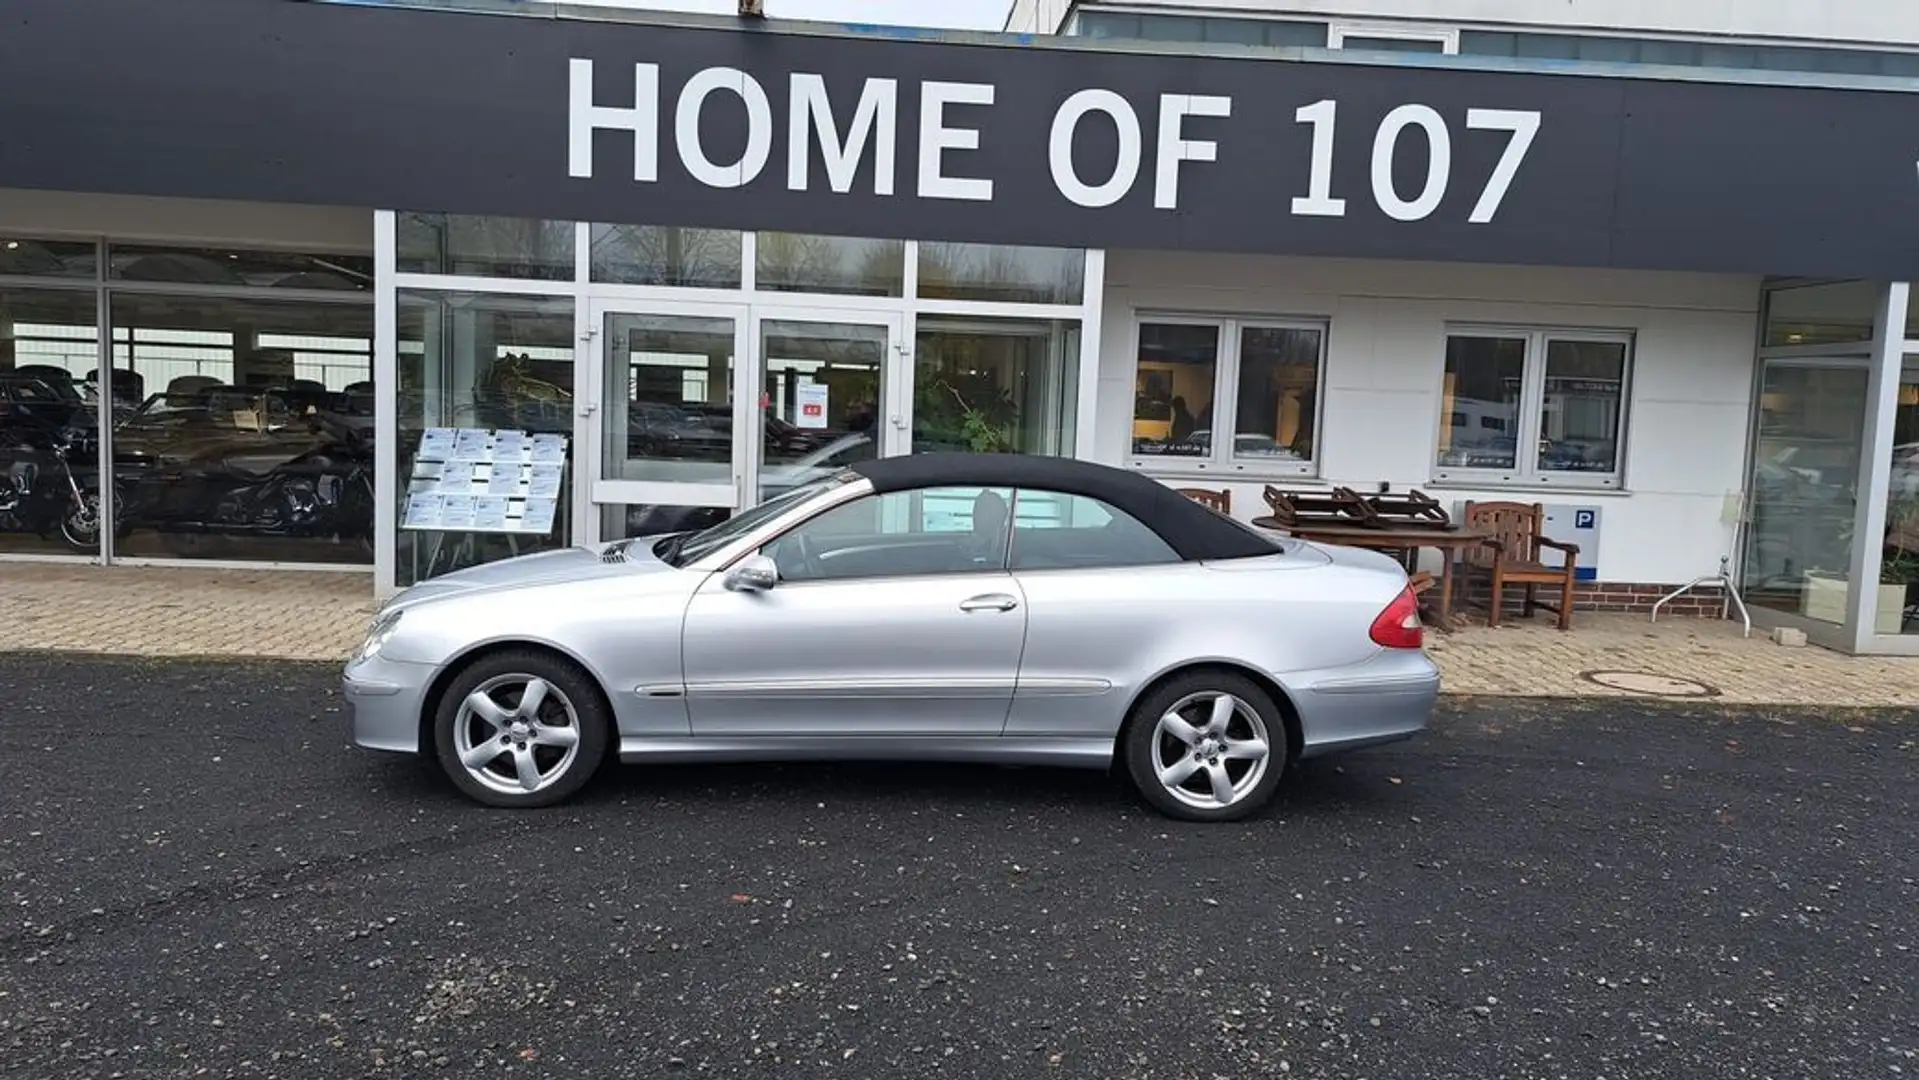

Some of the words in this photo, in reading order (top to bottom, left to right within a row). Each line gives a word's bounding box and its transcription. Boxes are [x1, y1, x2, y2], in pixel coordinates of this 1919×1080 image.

[568, 57, 995, 201] HOME
[1049, 88, 1232, 209] OF
[1290, 99, 1542, 223] 107
[1578, 512, 1591, 526] P
